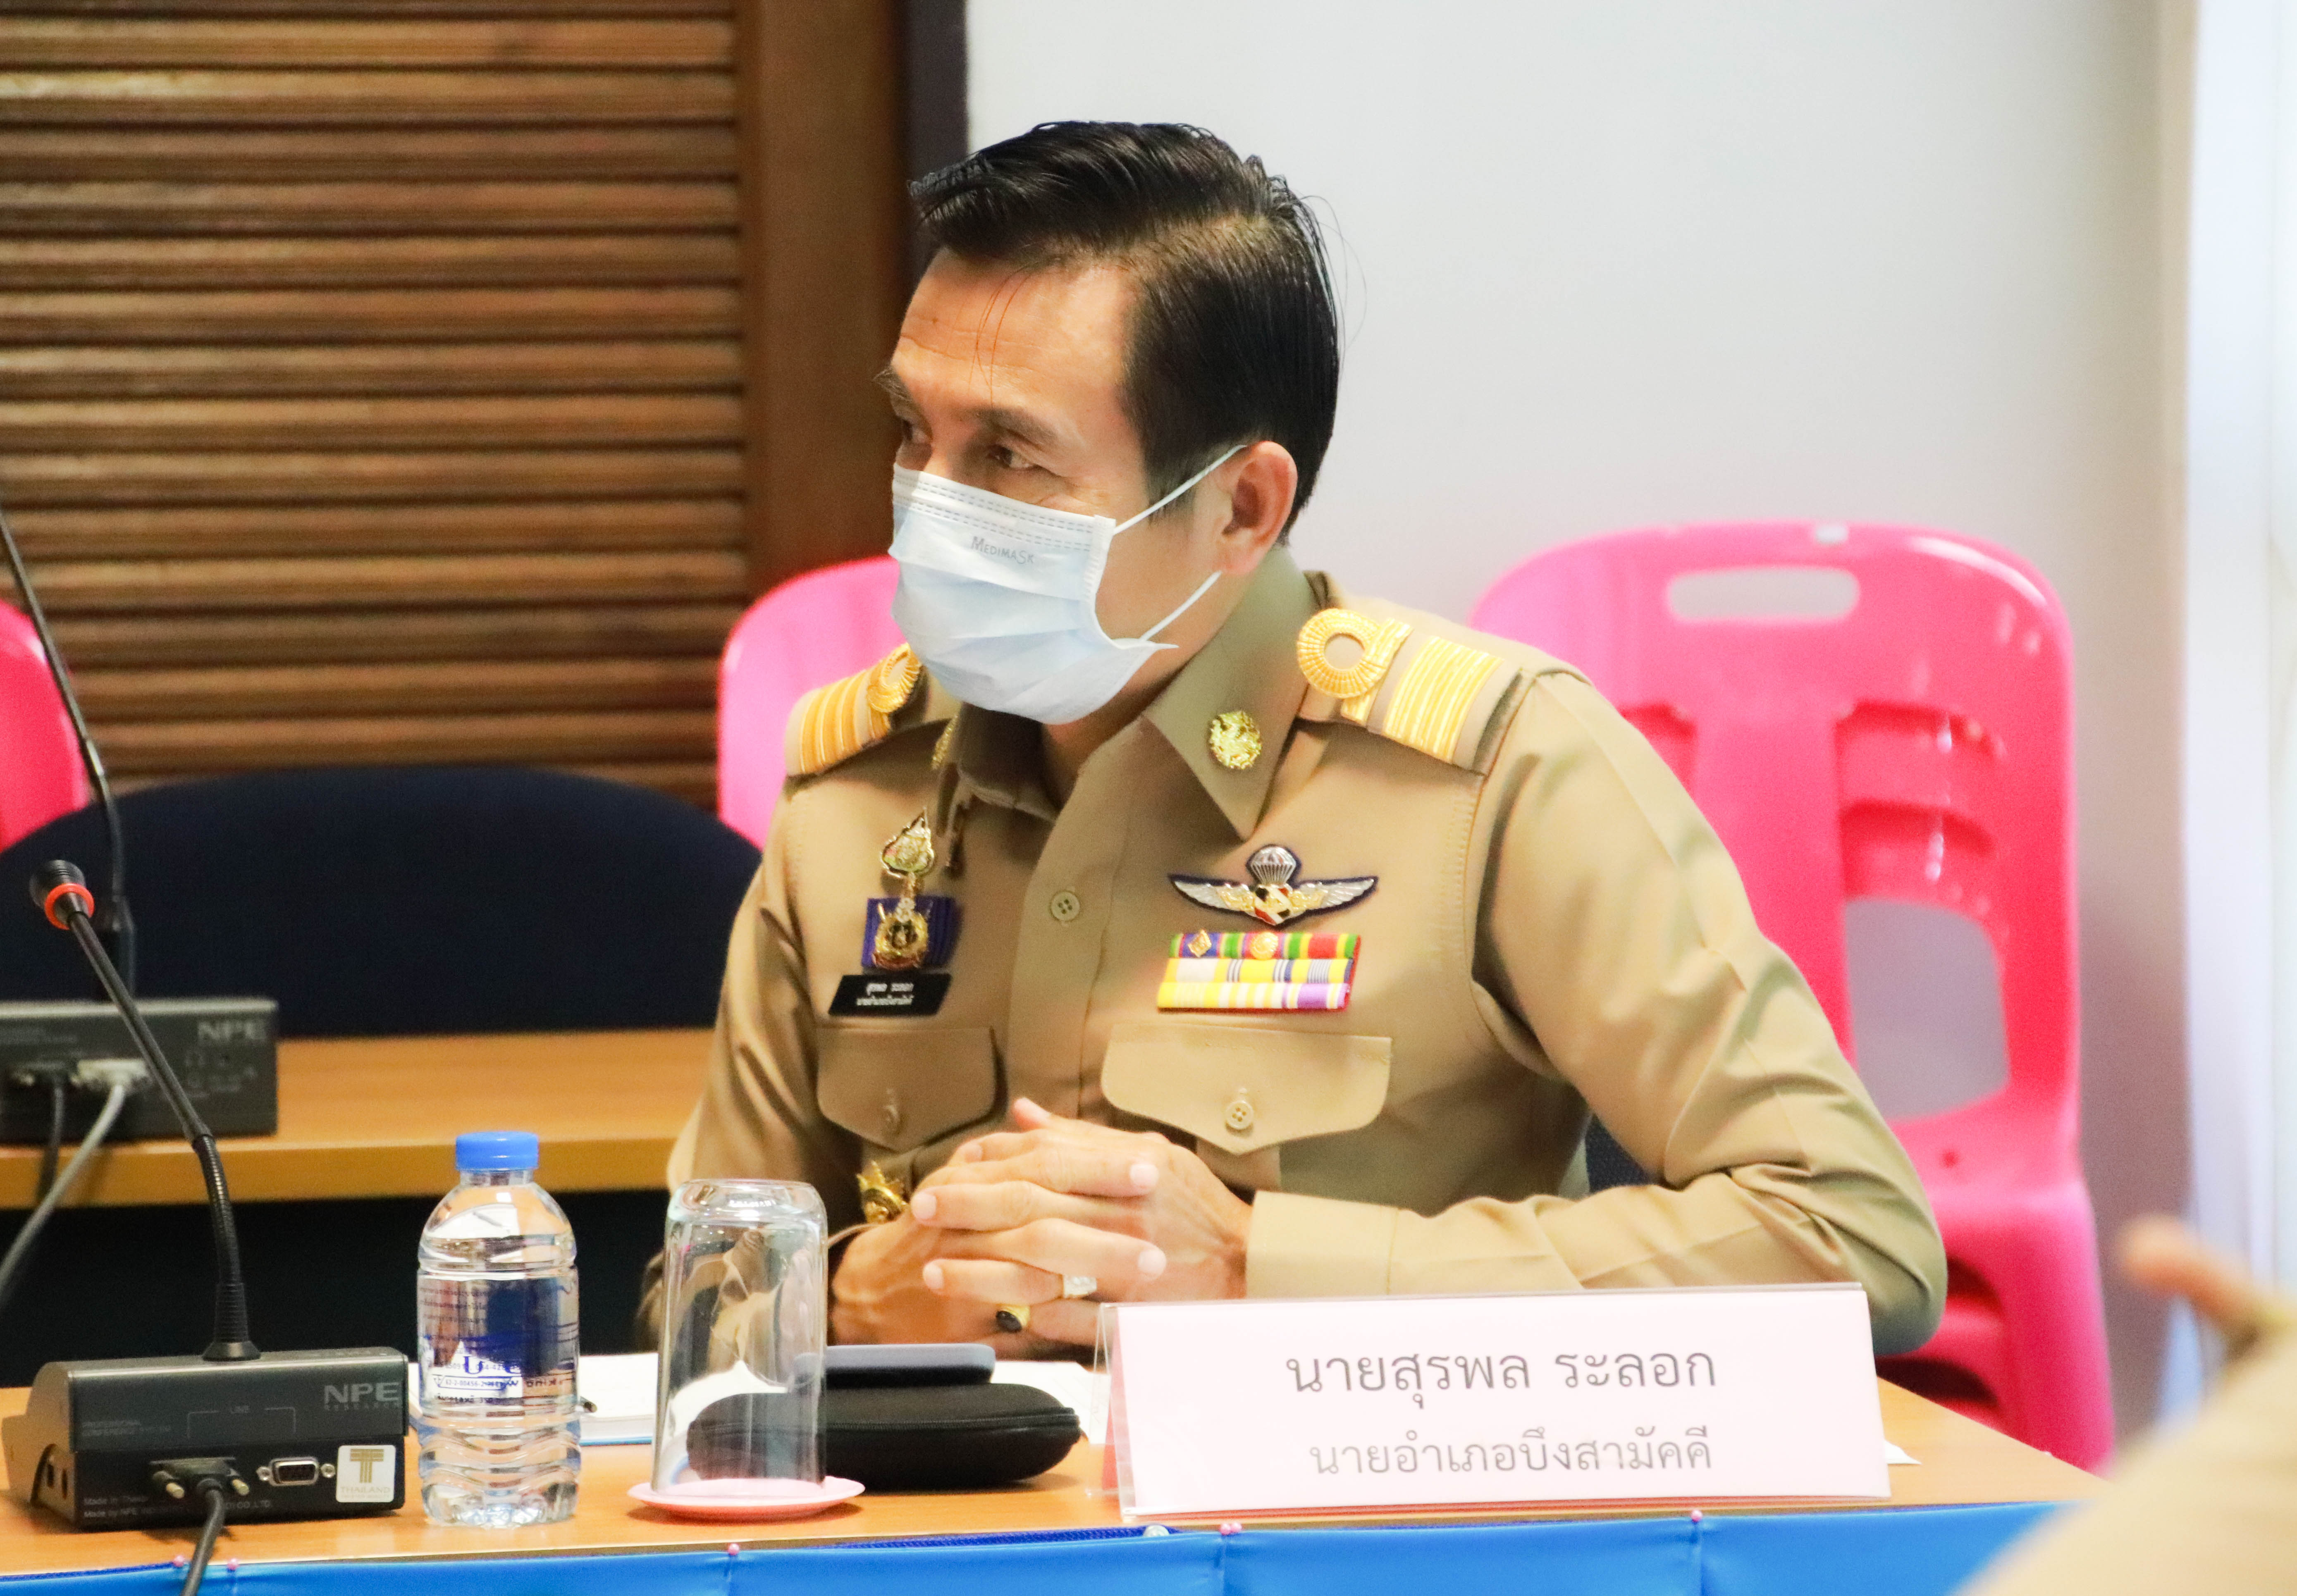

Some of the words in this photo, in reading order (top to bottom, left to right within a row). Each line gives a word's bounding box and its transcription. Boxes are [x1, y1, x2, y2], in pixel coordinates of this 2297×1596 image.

[325, 1381, 399, 1404] NPE
[1285, 1352, 1531, 1410] นายสุรพล
[1554, 1352, 1716, 1389] ระลอก
[1310, 1424, 1712, 1474] นายอำเภอบึงสามัคคี
